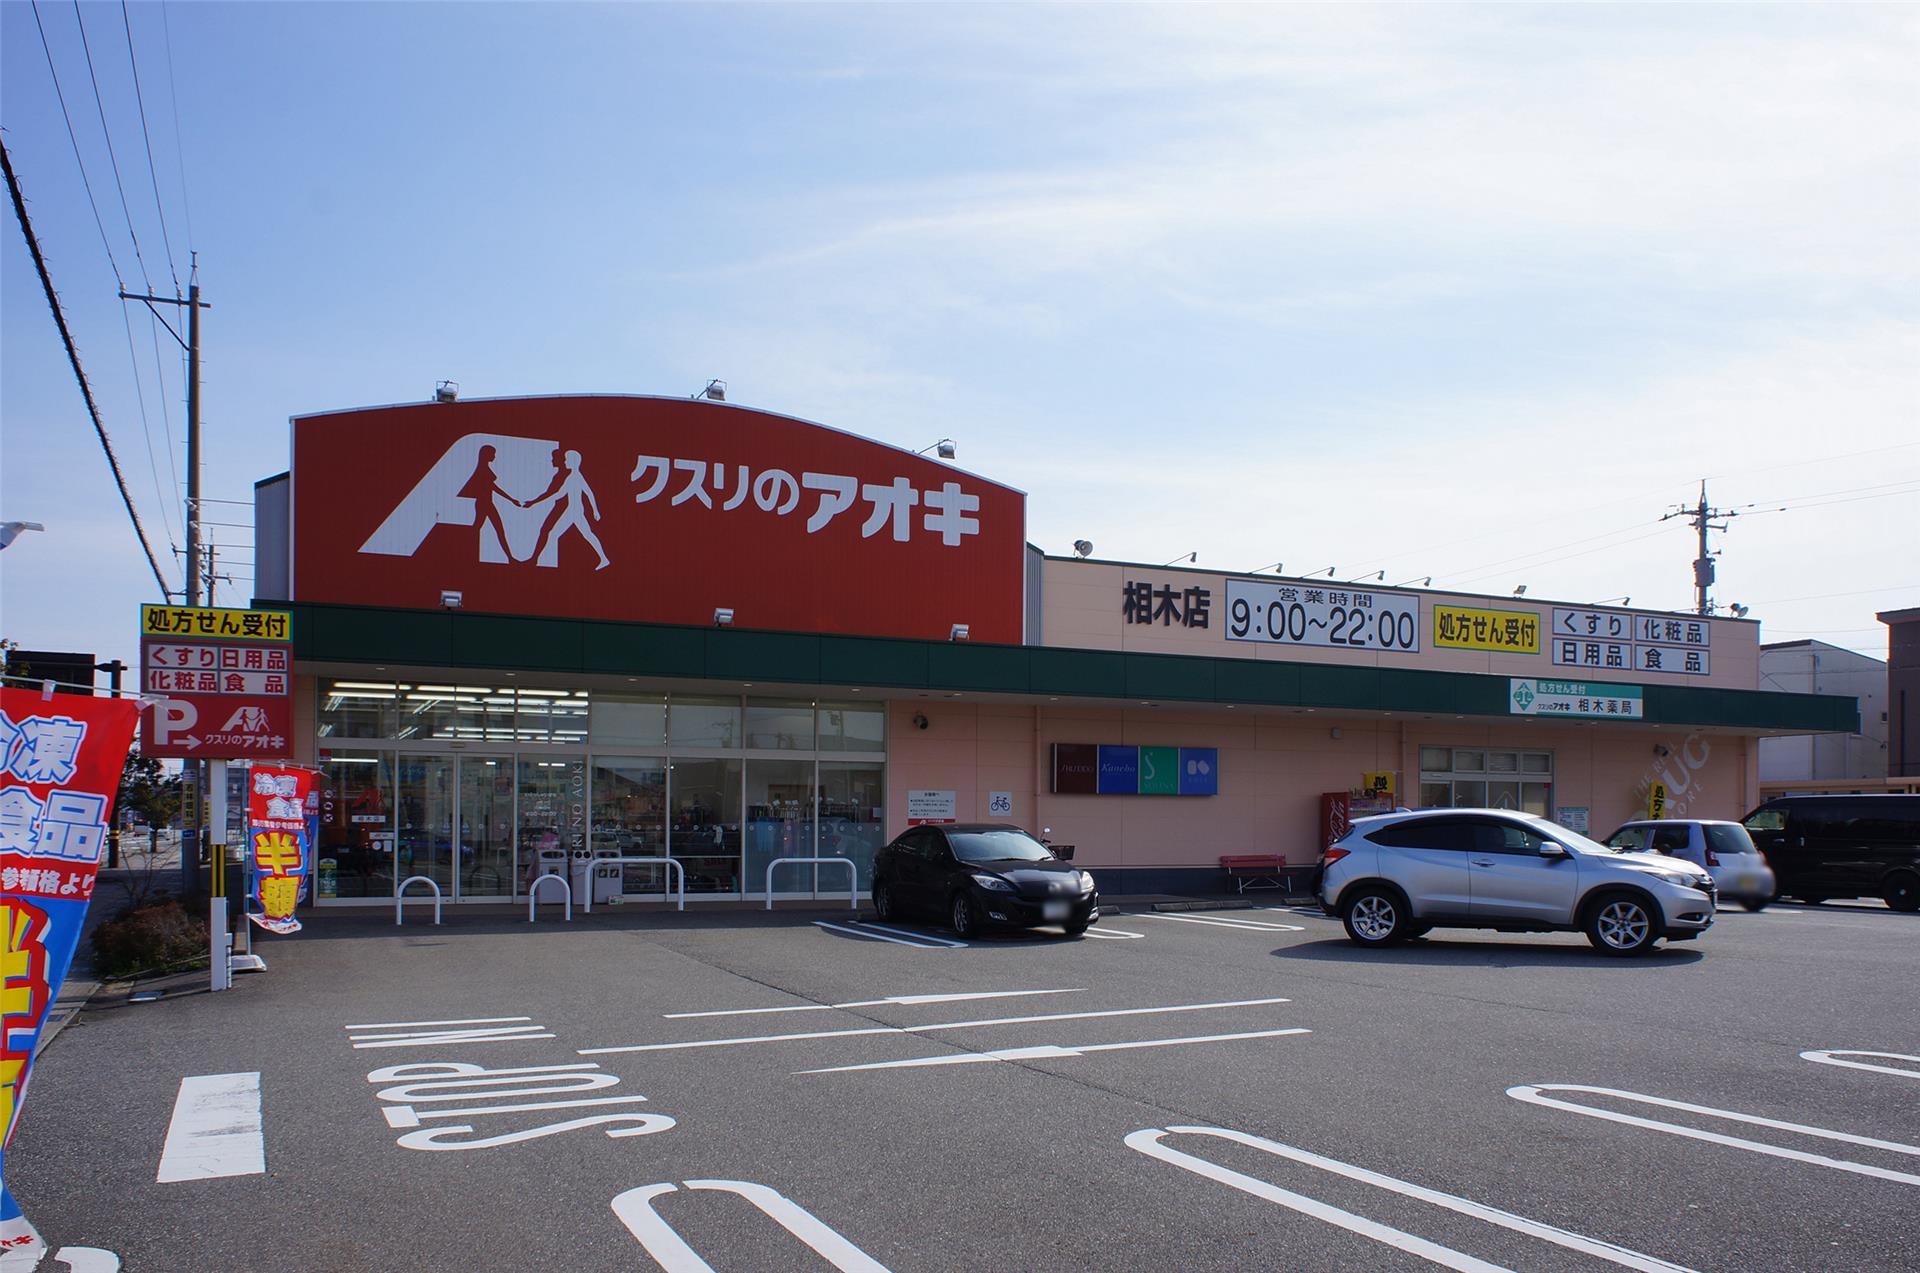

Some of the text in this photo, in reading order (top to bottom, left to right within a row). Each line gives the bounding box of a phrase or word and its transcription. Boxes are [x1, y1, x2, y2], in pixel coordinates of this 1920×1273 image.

[631, 454, 980, 547] クスリのアオキ
[1123, 581, 1210, 629] 相木店
[1279, 588, 1372, 608] 営業時間
[148, 609, 286, 638] 処方せん受付
[1439, 612, 1536, 648] 処方せん受付
[1563, 612, 1622, 635] くすり
[1644, 618, 1703, 643] 化粧品
[152, 646, 215, 667] くすり
[222, 649, 286, 670] 日用品
[1562, 641, 1622, 667] 日用品
[150, 671, 217, 691] 化粧品
[1538, 682, 1586, 695] 処方せん受付
[1578, 698, 1632, 715] 相木薬局
[153, 700, 198, 745] P
[205, 734, 285, 748] クスリのアオキ
[1101, 761, 1136, 774] Kanebo
[367, 1062, 678, 1151] STOP
